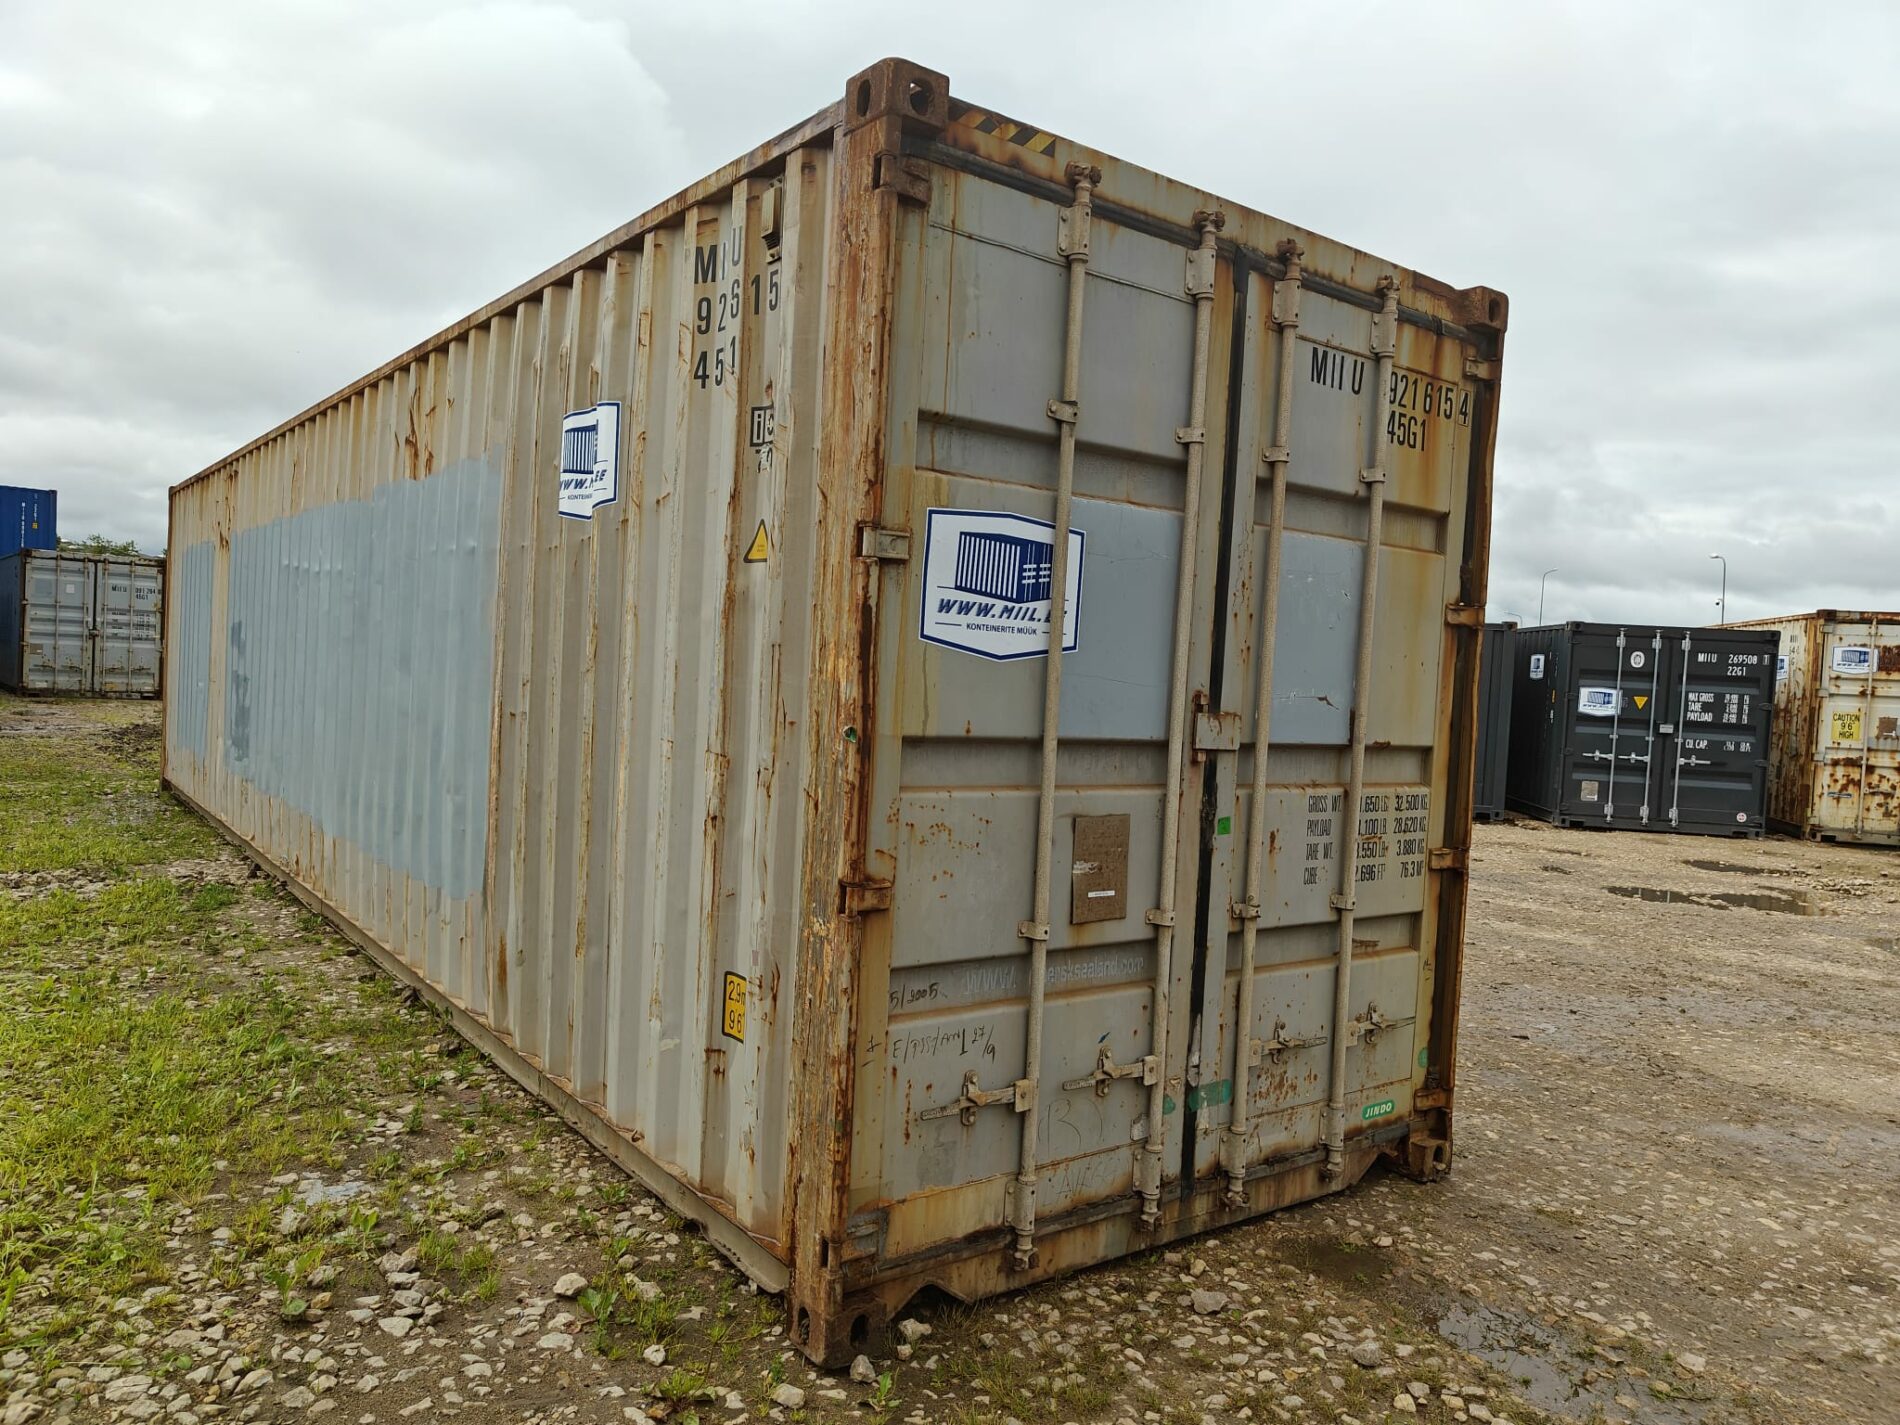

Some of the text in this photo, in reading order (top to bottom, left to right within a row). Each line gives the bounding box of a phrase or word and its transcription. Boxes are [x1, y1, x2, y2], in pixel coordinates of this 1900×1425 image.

[1311, 347, 1365, 395] MIIU
[1387, 410, 1426, 451] 45G1
[966, 622, 1037, 636] KONTEINERITE MÜÜK
[1698, 653, 1717, 662] MIIU
[1727, 666, 1746, 676] 22G1
[1688, 692, 1715, 703] MAX GROSS
[1688, 702, 1702, 711] TARE
[1686, 711, 1713, 721] PAYLOAD
[1833, 713, 1861, 722] CAUTION
[1838, 731, 1854, 740] HIGH
[1308, 795, 1328, 813] GROSS
[1306, 818, 1332, 837] PAYLOAD
[1306, 842, 1320, 861] TARE
[1303, 866, 1318, 885] CUBE
[1365, 1102, 1392, 1118] JINDO
